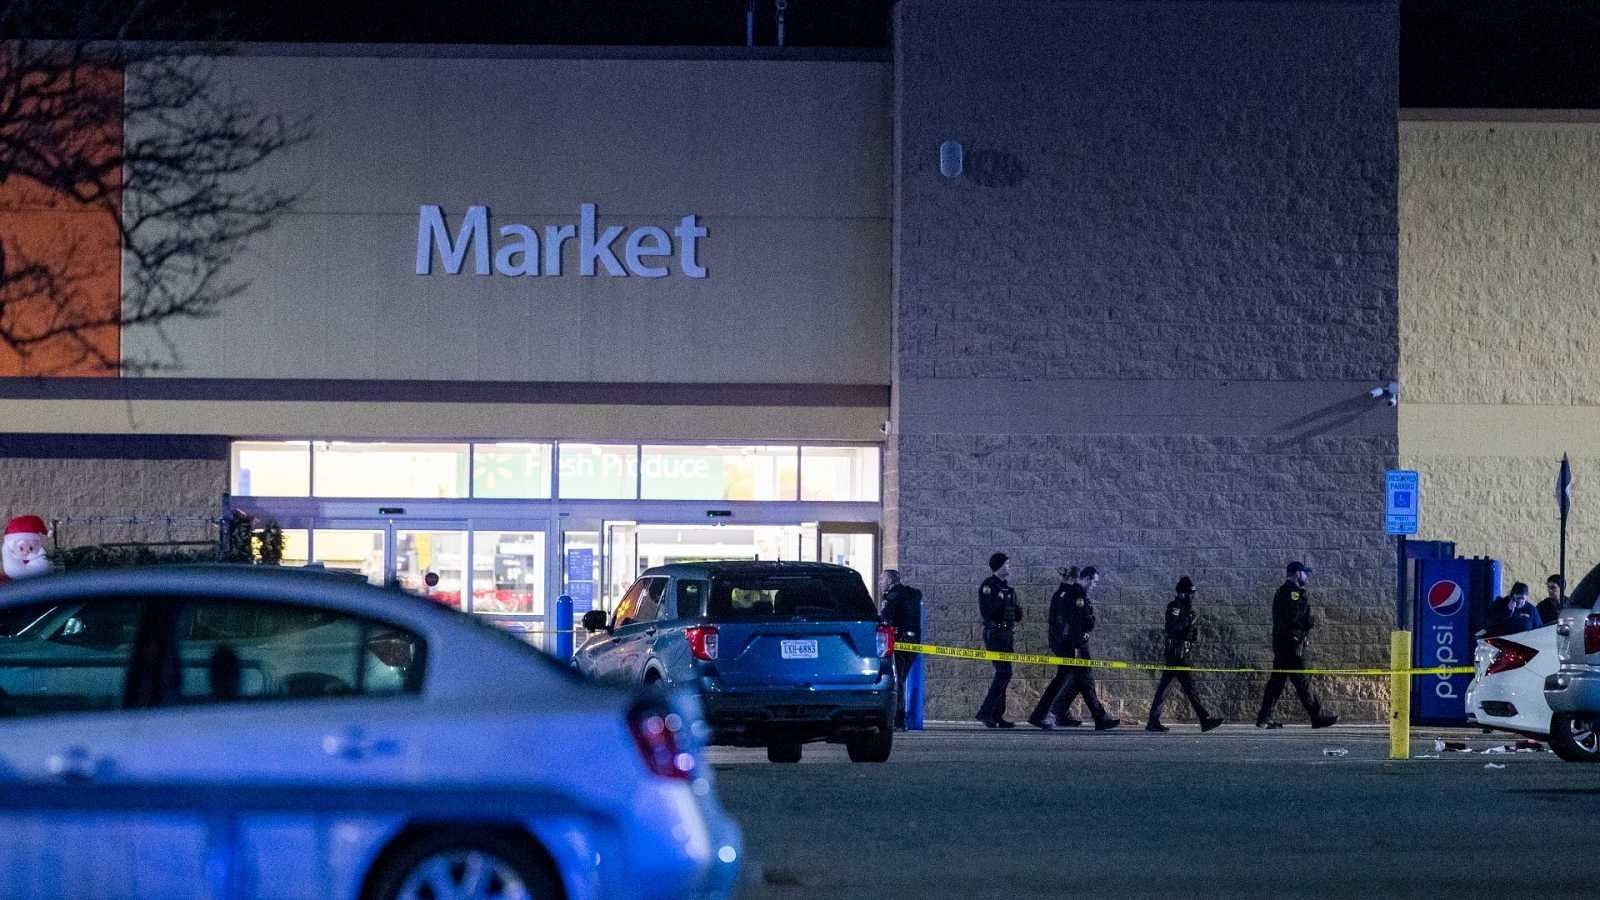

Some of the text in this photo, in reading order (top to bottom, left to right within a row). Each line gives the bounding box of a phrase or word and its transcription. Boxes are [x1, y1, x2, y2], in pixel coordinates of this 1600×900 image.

[416, 203, 707, 278] Market
[525, 453, 593, 479] Fsh
[1433, 625, 1458, 698] pepsi
